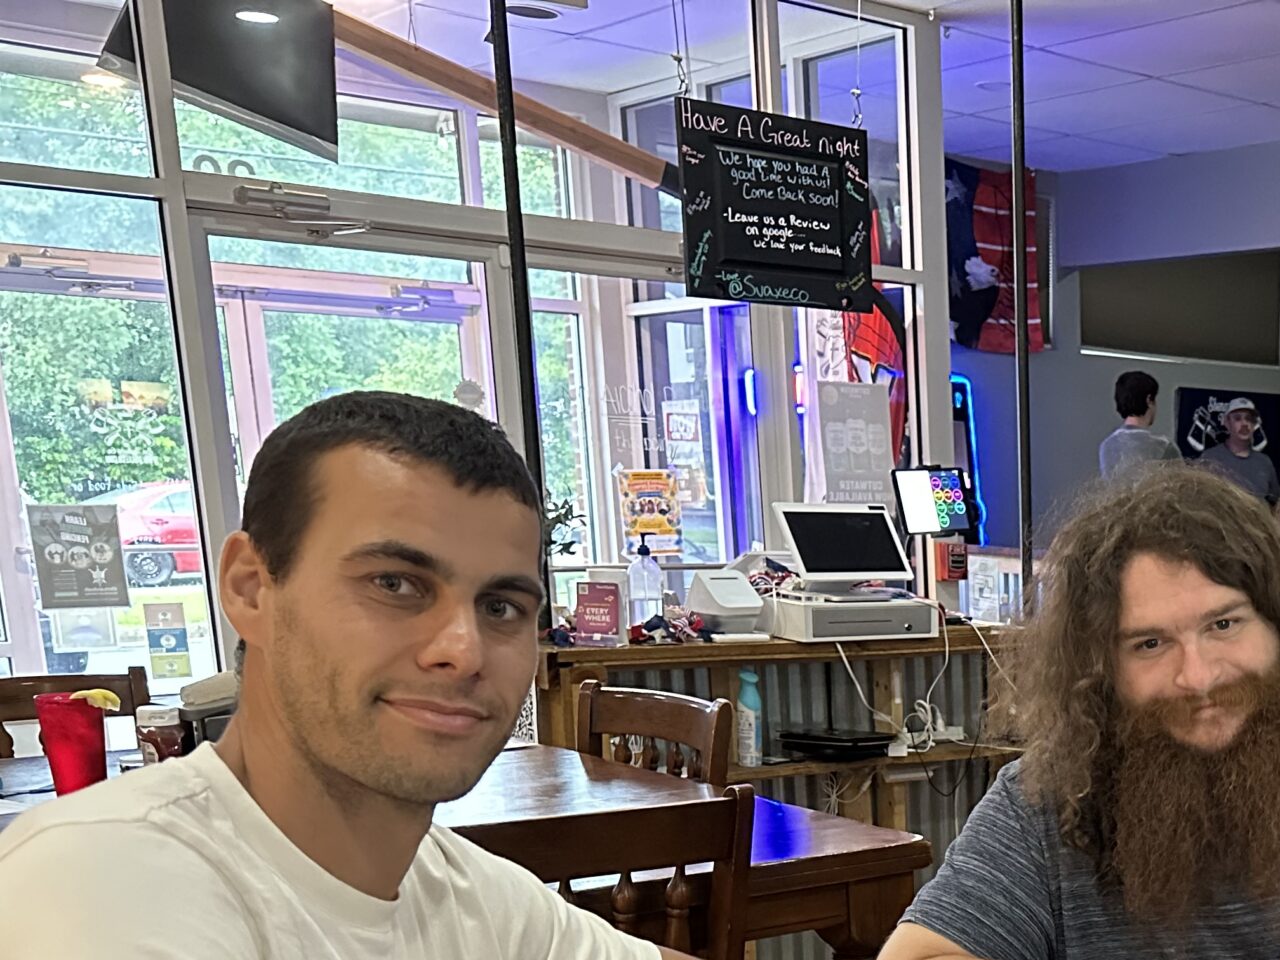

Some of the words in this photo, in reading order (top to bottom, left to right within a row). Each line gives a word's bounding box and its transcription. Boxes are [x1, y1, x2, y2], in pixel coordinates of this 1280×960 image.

[681, 98, 728, 134] Have
[737, 114, 754, 139] A
[759, 117, 811, 148] Great
[818, 137, 860, 158] night
[719, 152, 742, 166] We
[747, 154, 768, 173] hope
[773, 160, 791, 177] you
[796, 163, 816, 175] had
[822, 166, 830, 178] A
[731, 167, 756, 185] good
[815, 176, 831, 189] us!
[743, 182, 774, 200] Come
[778, 187, 805, 203] Back
[809, 190, 839, 208] soon!
[745, 226, 758, 236] on
[764, 215, 775, 225] us
[779, 217, 787, 226] a
[789, 215, 831, 230] Review
[753, 240, 767, 248] we
[789, 242, 806, 253] your
[809, 242, 842, 257] feedback
